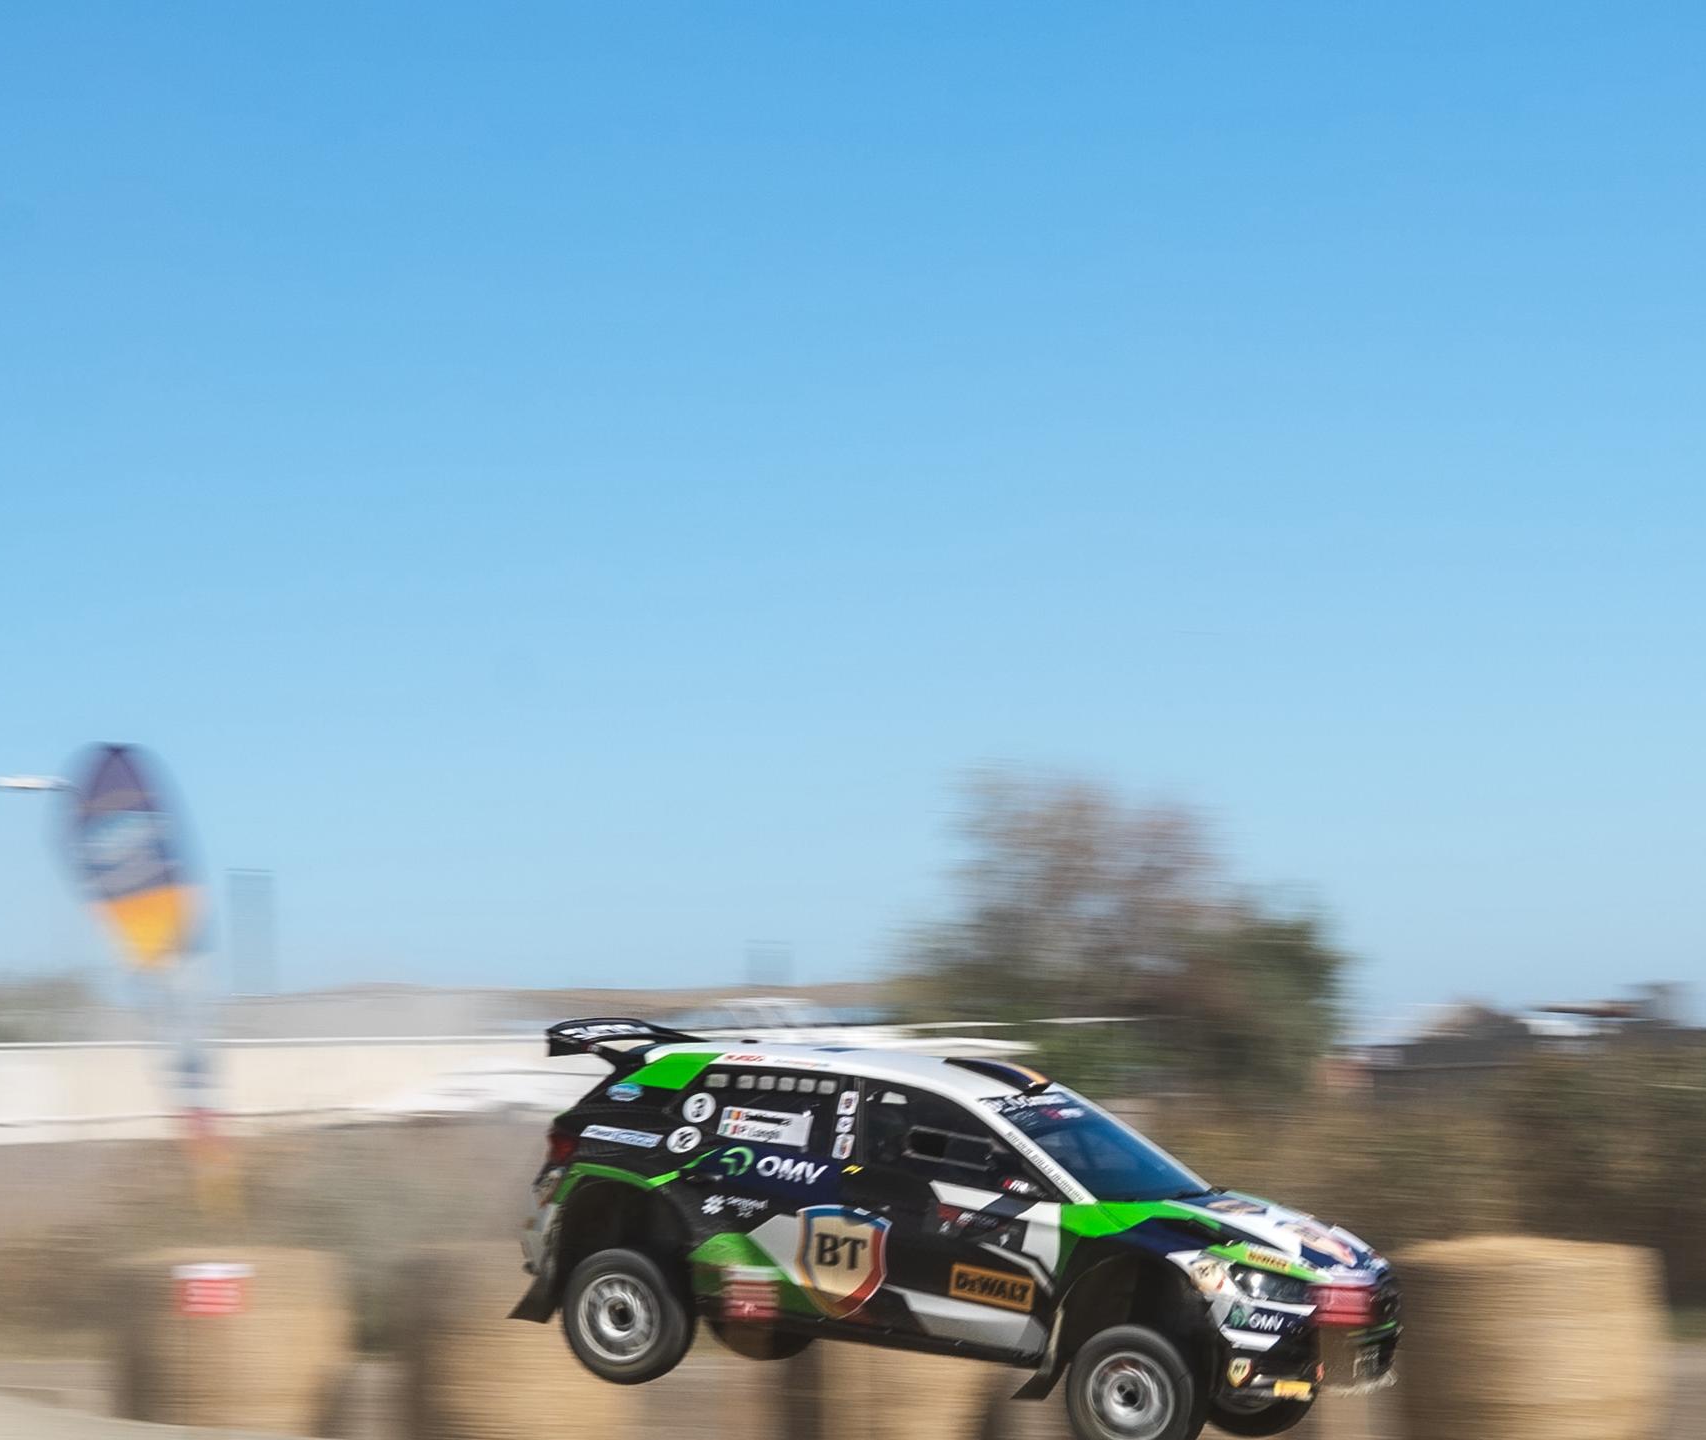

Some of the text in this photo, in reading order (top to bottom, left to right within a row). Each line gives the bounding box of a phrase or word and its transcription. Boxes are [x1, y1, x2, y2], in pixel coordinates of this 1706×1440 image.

[756, 1155, 829, 1185] OMV
[814, 1232, 868, 1271] BT
[1248, 1312, 1285, 1332] OMV
